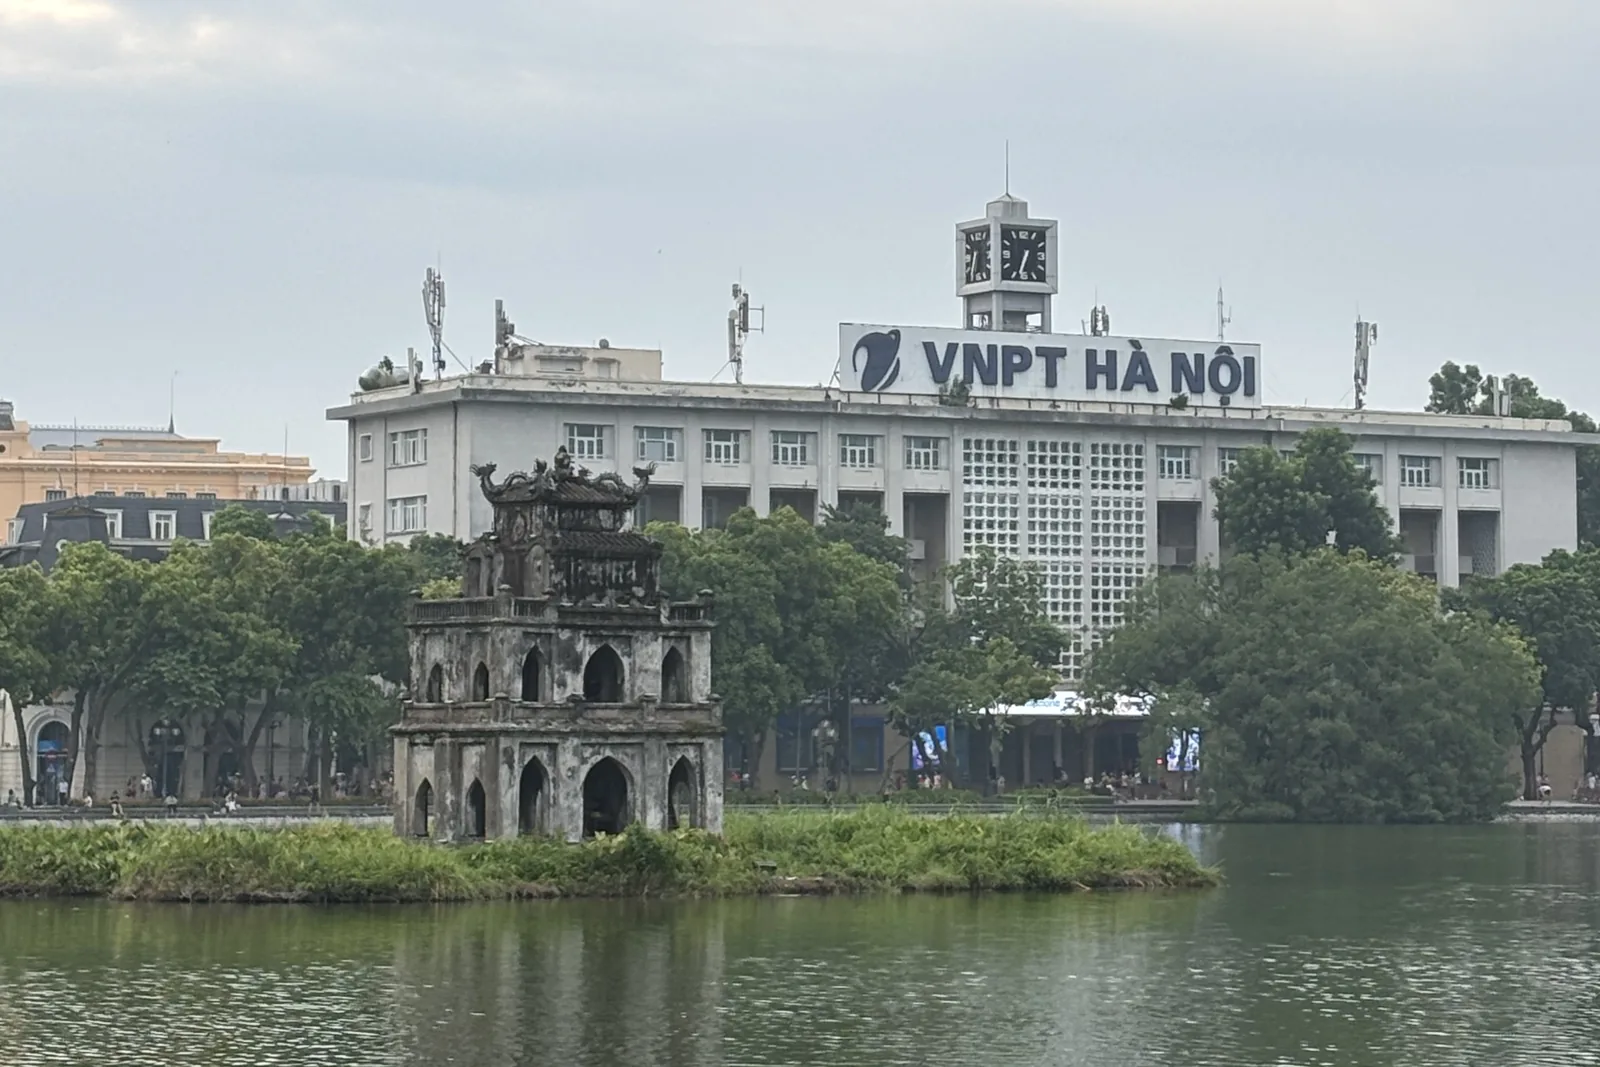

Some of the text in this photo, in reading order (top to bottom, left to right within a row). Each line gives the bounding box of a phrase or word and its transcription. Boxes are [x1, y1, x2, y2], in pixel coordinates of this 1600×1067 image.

[1018, 231, 1028, 239] 12
[1002, 250, 1010, 259] 9
[1037, 252, 1045, 260] 3
[1020, 271, 1028, 280] 6
[922, 339, 1256, 406] VNPT HÀ NỘI
